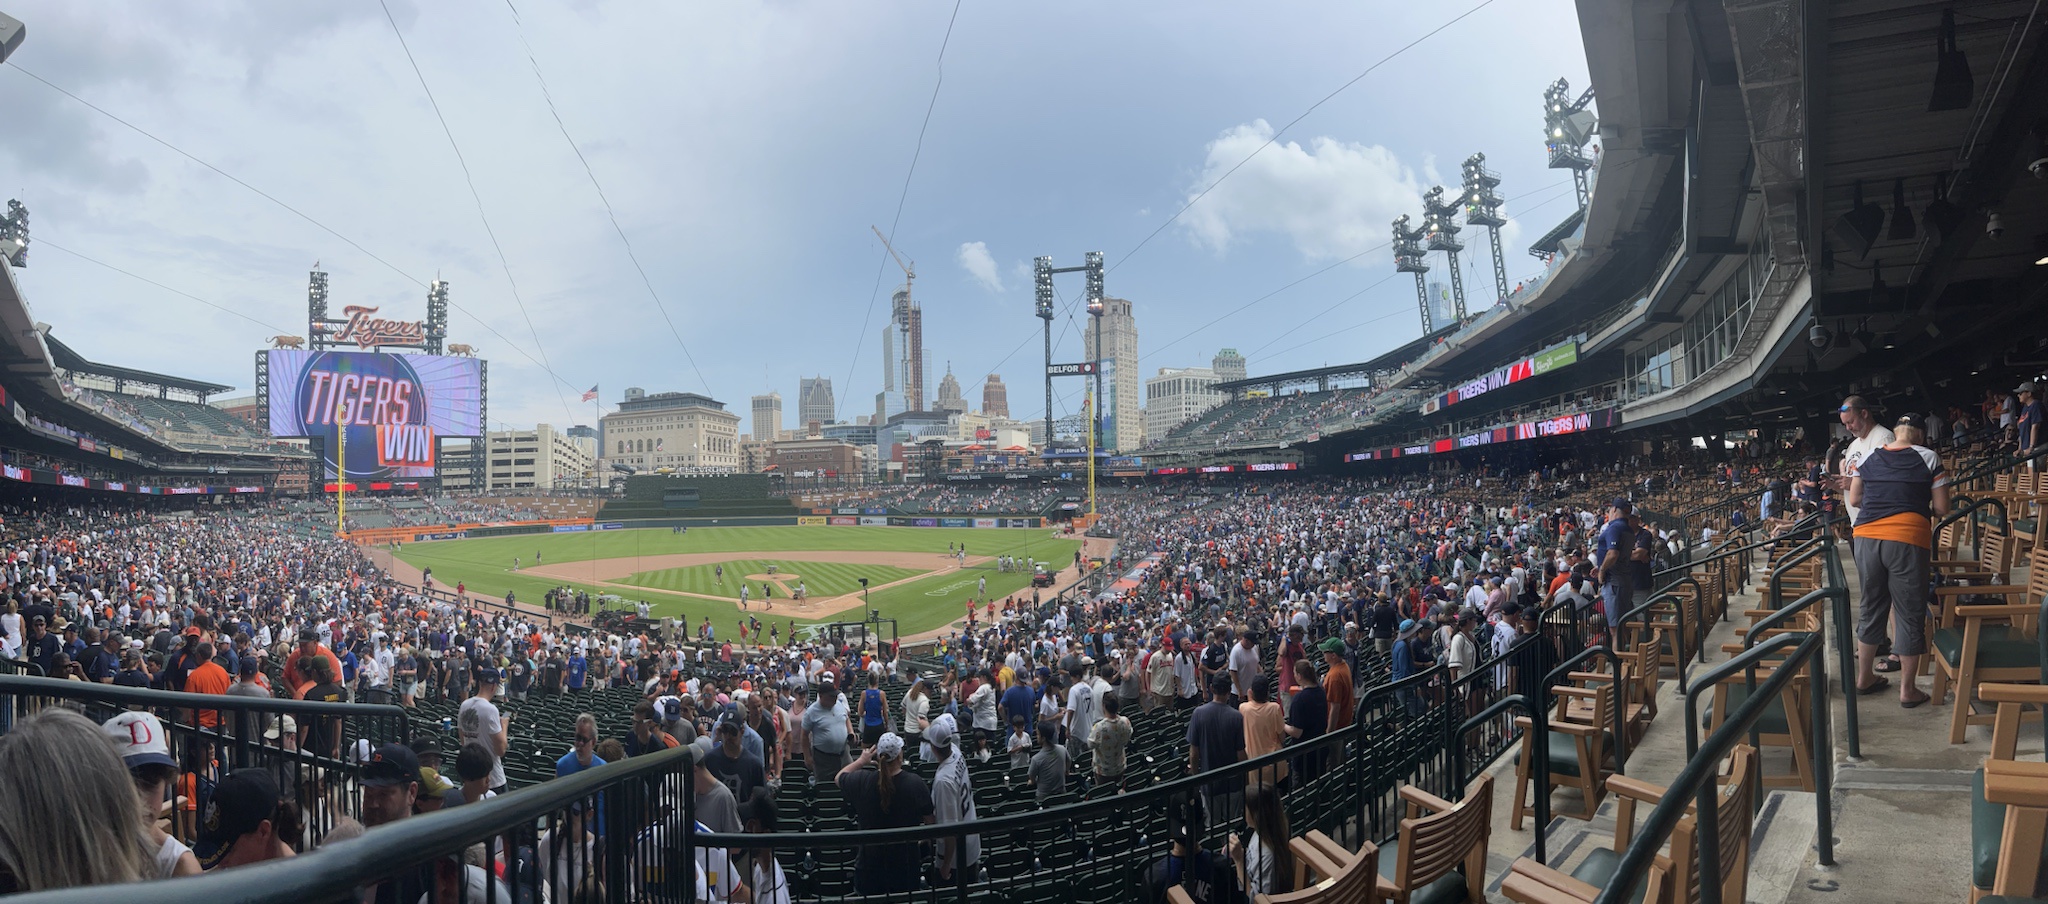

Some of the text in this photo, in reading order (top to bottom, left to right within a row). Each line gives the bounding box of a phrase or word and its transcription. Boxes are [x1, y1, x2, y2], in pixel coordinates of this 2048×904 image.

[333, 305, 425, 350] Tigers
[1047, 365, 1079, 374] BELFOR
[1458, 369, 1504, 401] TIGERS WIN
[306, 370, 413, 426] TIGERS
[1538, 413, 1592, 436] TIGERS WIN
[384, 423, 430, 462] WIN
[1459, 431, 1491, 447] TIGERS WIN
[1405, 446, 1422, 455] TIGERS
[679, 466, 736, 474] CHEVROLET
[794, 470, 815, 478] meijer
[915, 519, 933, 527] xfinity
[126, 720, 153, 747] D
